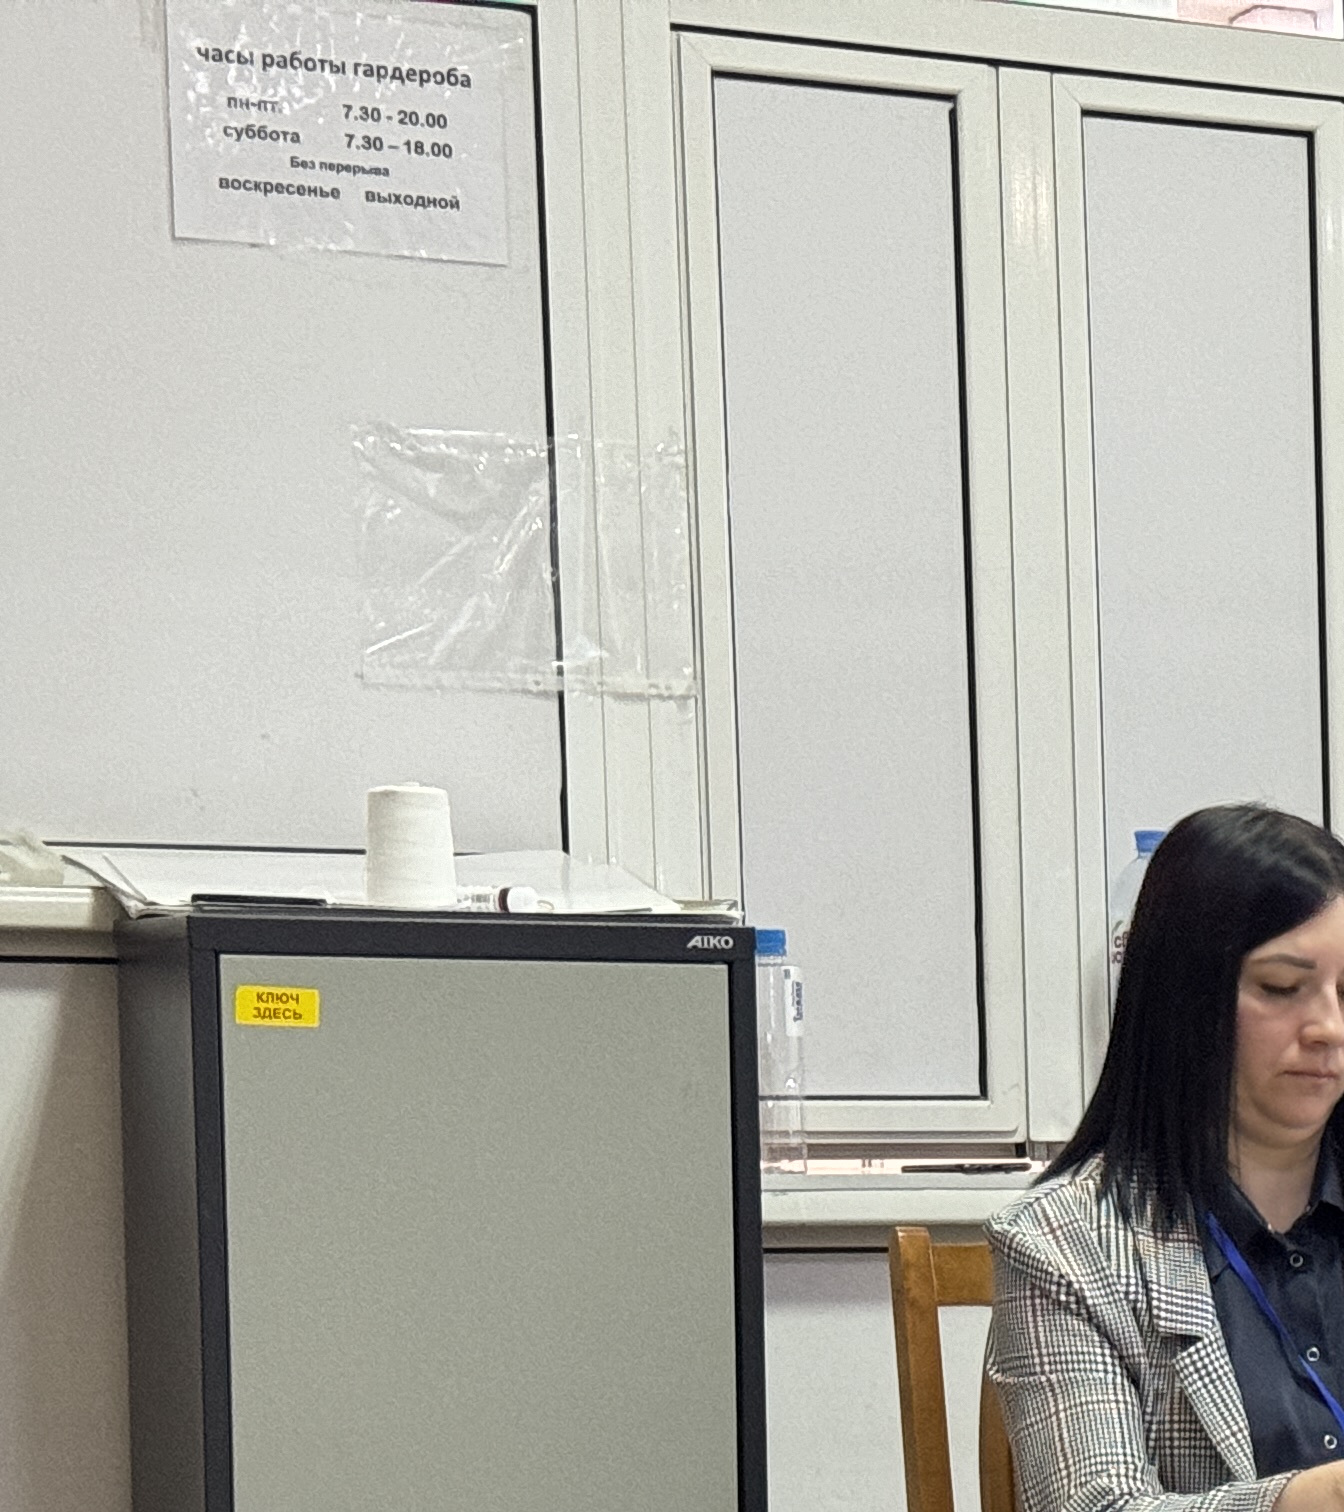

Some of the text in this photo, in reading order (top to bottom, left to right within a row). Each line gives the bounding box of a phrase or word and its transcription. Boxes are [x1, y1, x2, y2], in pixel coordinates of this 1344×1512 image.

[195, 46, 472, 89] часы работы гардероба
[342, 103, 382, 123] 7.30
[397, 109, 448, 129] 20.00
[223, 123, 301, 144] суббота
[344, 133, 384, 152] 7.30
[402, 139, 453, 159] 18.00
[289, 155, 390, 177] Без перерыва
[218, 177, 460, 211] воскресенье выходной
[686, 935, 735, 949] AIKO
[256, 991, 300, 1005] КЛЮЧ
[252, 1006, 303, 1020] ЗДЕСЬ
